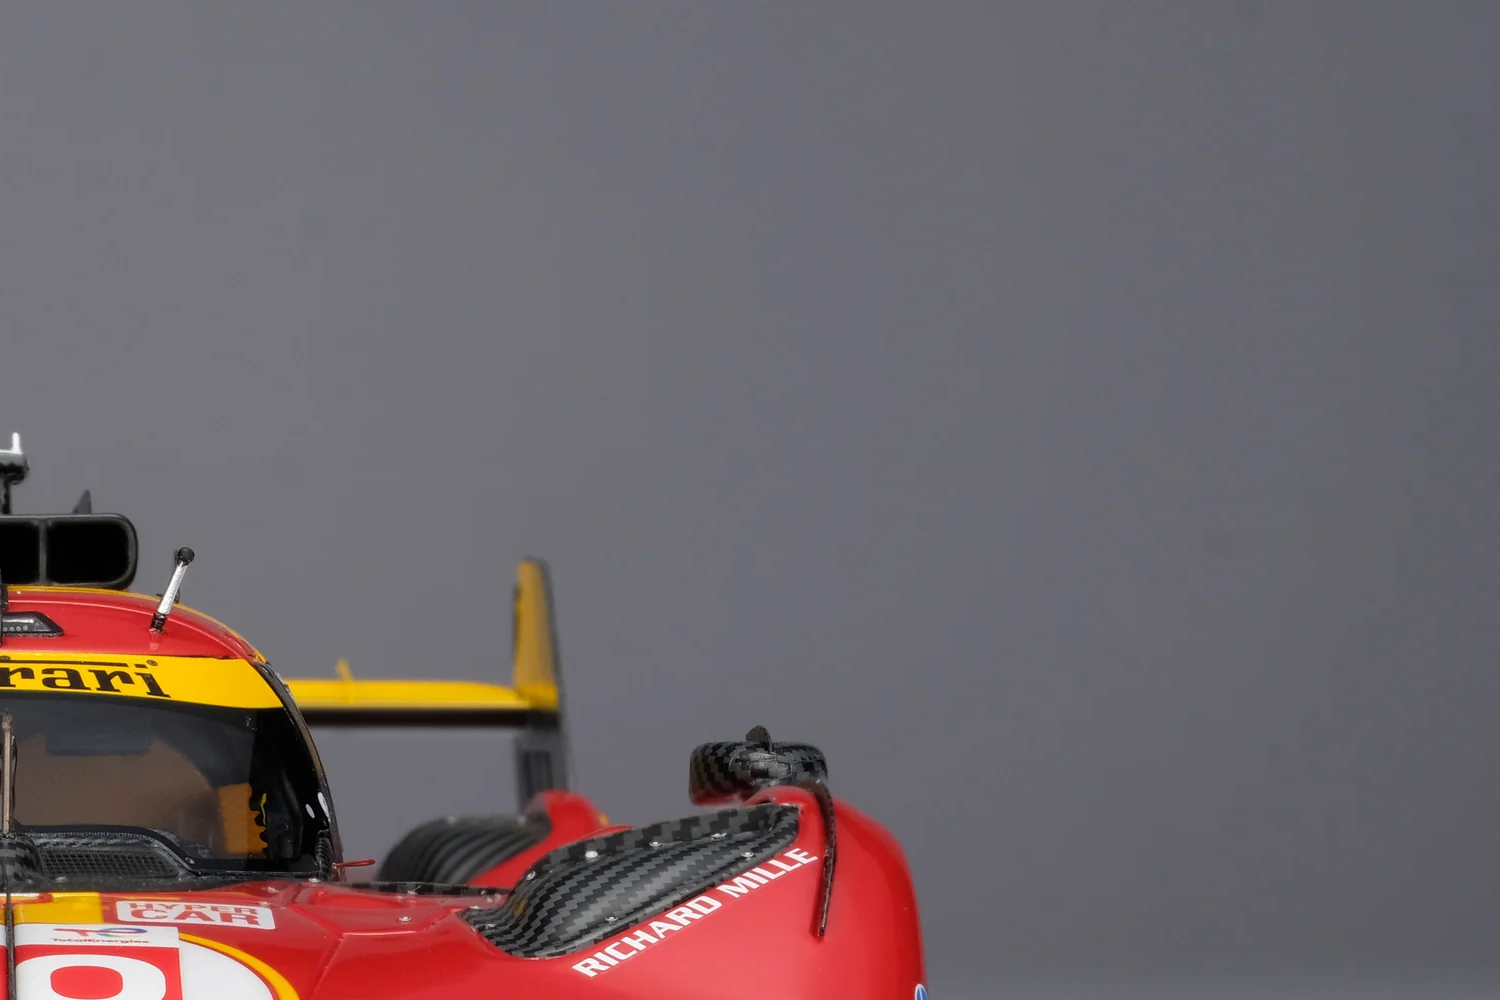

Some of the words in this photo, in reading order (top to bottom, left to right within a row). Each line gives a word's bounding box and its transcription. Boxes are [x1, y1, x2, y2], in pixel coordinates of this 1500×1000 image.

[129, 903, 258, 915] HYPER
[131, 909, 261, 926] CAR
[572, 894, 722, 978] RICHARD
[716, 847, 818, 899] MILLE
